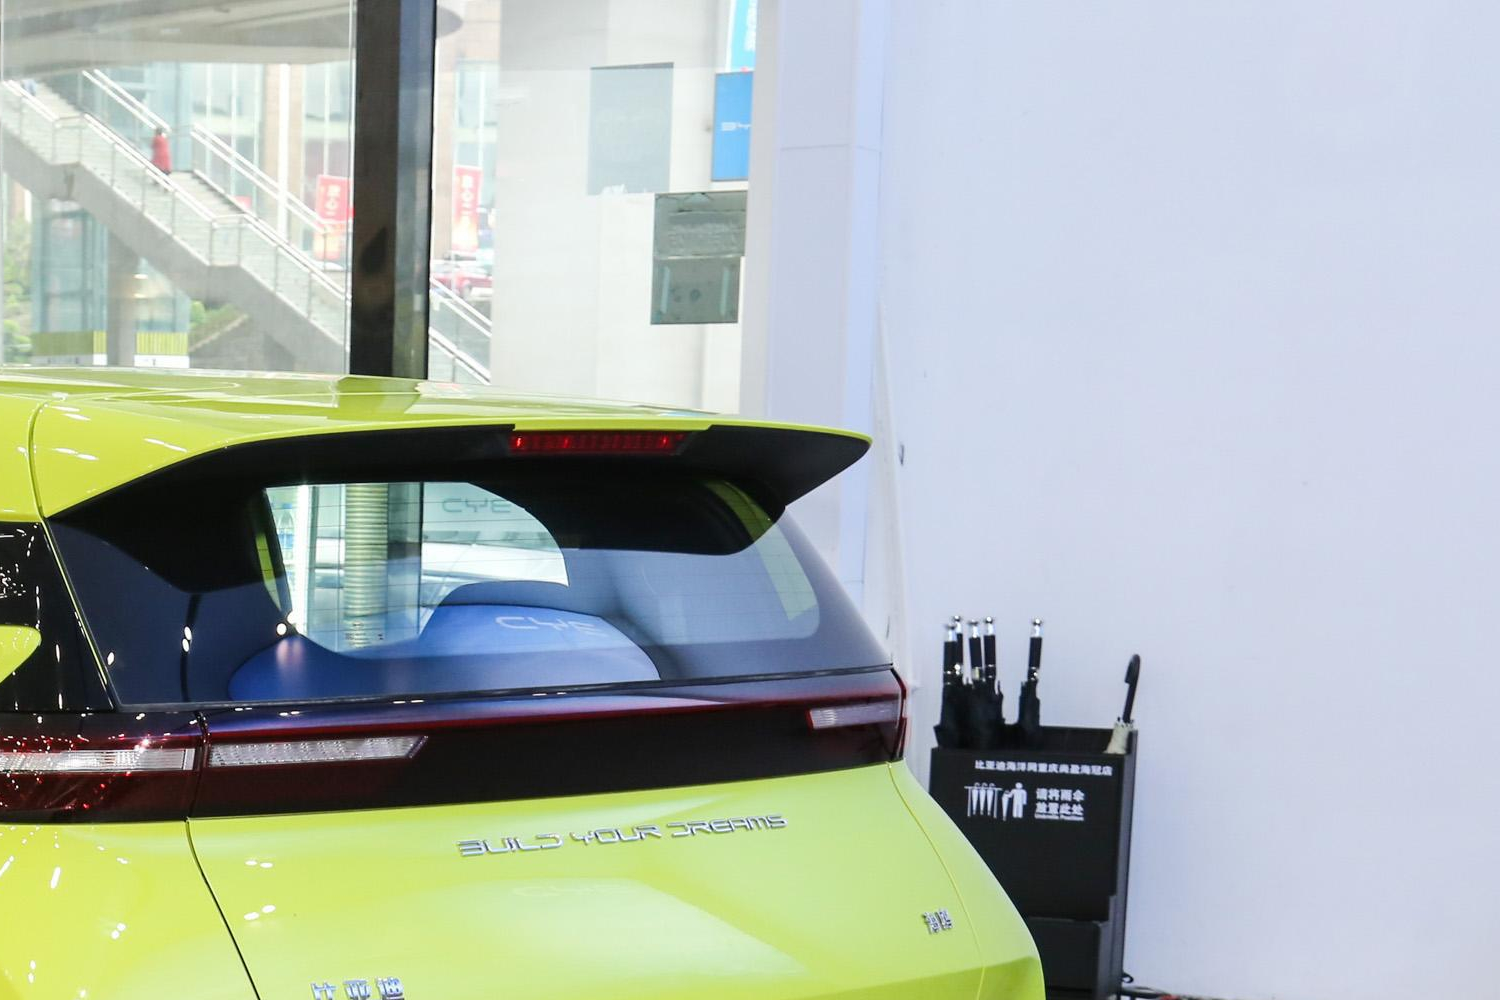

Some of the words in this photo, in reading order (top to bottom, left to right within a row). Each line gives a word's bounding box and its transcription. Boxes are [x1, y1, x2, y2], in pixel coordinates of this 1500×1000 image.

[457, 833, 564, 857] BUILD
[571, 824, 663, 846] YOUR
[667, 813, 789, 838] DREAMS
